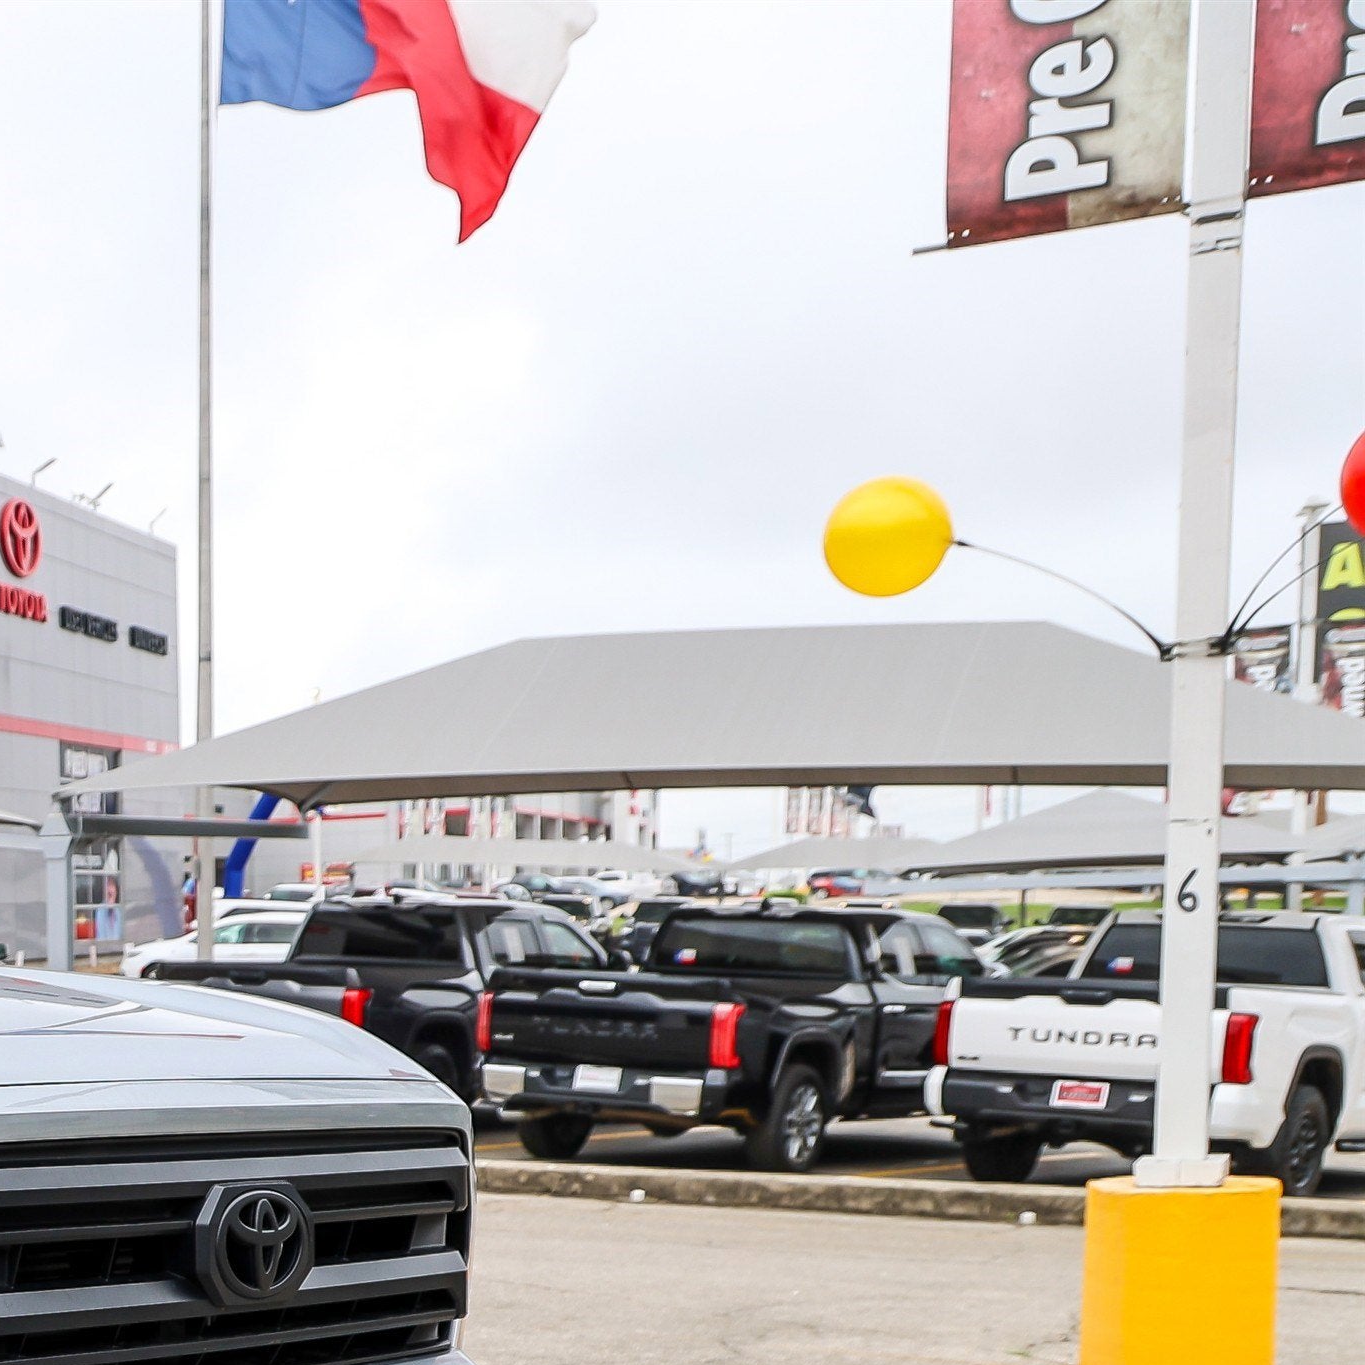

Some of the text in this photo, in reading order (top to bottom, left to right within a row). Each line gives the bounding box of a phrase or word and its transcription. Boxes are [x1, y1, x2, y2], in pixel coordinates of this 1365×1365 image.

[1004, 33, 1116, 202] Pre
[1177, 868, 1198, 913] 6
[1007, 1026, 1159, 1048] TUNDRA
